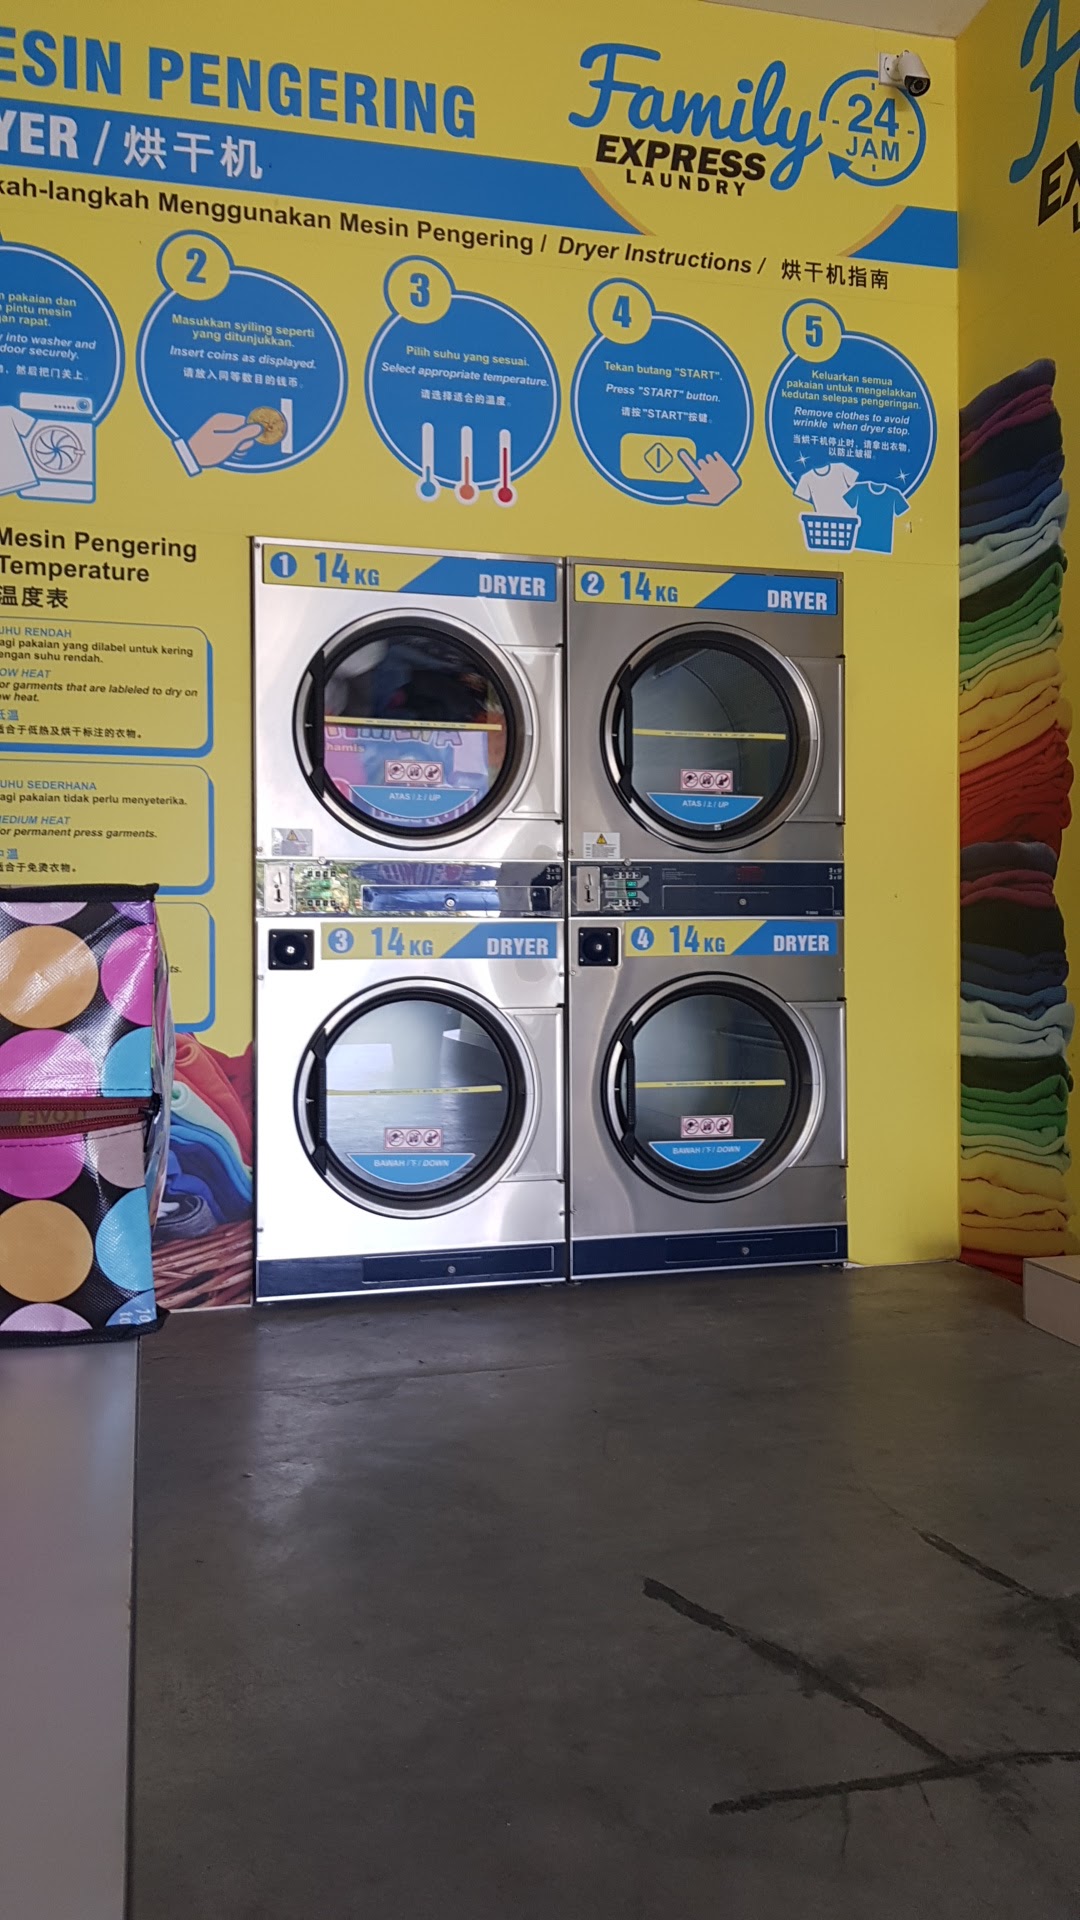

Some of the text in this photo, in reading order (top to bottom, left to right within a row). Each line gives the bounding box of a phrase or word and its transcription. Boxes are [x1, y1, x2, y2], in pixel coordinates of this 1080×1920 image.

[148, 46, 476, 138] PENGERING
[568, 42, 823, 191] Family
[847, 94, 900, 138] 24
[93, 121, 111, 166] /
[123, 124, 263, 180] 烘干机
[595, 134, 766, 181] EXPRESS
[846, 137, 900, 163] JAM
[626, 170, 746, 197] LAUNDRY
[159, 192, 331, 229] Menggunakan
[340, 212, 409, 238] Mesin
[417, 220, 533, 255] Pengering
[540, 234, 547, 252] /
[558, 236, 619, 261] Dryer
[625, 243, 752, 274] Instructions
[757, 257, 767, 275] /
[781, 259, 889, 290] 烘干机指南
[185, 248, 207, 284] 2
[8, 293, 53, 304] pakaian
[56, 297, 77, 307] dan
[410, 272, 430, 308] 3
[6, 304, 34, 314] pintu
[38, 307, 73, 318] mesin
[612, 295, 632, 329] 4
[172, 313, 315, 338] Masukkan syiling seperti
[804, 315, 824, 348] 5
[6, 333, 28, 343] into
[31, 337, 72, 347] washer
[75, 341, 96, 350] and
[192, 329, 295, 348] yang ditunjukkan.
[0, 344, 80, 361] door securely.
[170, 345, 316, 370] Insert coins as displayed.
[406, 345, 530, 367] Pilih suhu yang sesuai.
[381, 362, 550, 387] Select appropriate temperature.
[604, 361, 634, 373] Tekan
[637, 364, 672, 378] butang
[812, 370, 893, 386] Keluarkan semua
[605, 383, 721, 402] Press "START" button.
[782, 389, 922, 410] kedutan selepas pengeringan.
[786, 380, 917, 398] pakaian untuk mengelakkan
[794, 406, 910, 425] Remove clothes to avoid
[793, 418, 910, 436] wrinkle when dryer stop.
[0, 527, 197, 563] Mesin Pengering
[0, 555, 150, 582] Temperature
[279, 552, 546, 597] 1 14 KG DRYER
[0, 585, 69, 609] 温度表
[587, 571, 828, 611] 2 14 KG DRYER
[24, 627, 72, 638] RENDAH
[18, 639, 60, 650] pakaian
[62, 642, 89, 653] yang
[91, 641, 126, 653] dilabel
[129, 644, 158, 654] untuk
[161, 646, 193, 658] kering
[34, 652, 61, 661] suhu
[63, 653, 104, 663] rendah.
[21, 668, 51, 678] HEAT
[13, 682, 63, 692] garments
[66, 683, 87, 692] that
[89, 685, 106, 693] are
[152, 687, 162, 696] to
[165, 687, 182, 699] dry
[185, 689, 198, 697] on
[13, 693, 40, 702] heat.
[27, 780, 97, 791] SEDERHANA
[19, 793, 60, 804] pakaian
[63, 794, 89, 804] tidak
[92, 794, 119, 805] perlu
[122, 796, 187, 806] menyeterika.
[389, 793, 410, 801] ATAS
[0, 815, 71, 825] EDIUM HEAT
[13, 827, 71, 837] permanent
[73, 829, 103, 838] press
[105, 829, 158, 839] garments.
[335, 927, 549, 957] 3 14 KG DRYER
[637, 925, 829, 953] 4 14 KG DRYER
